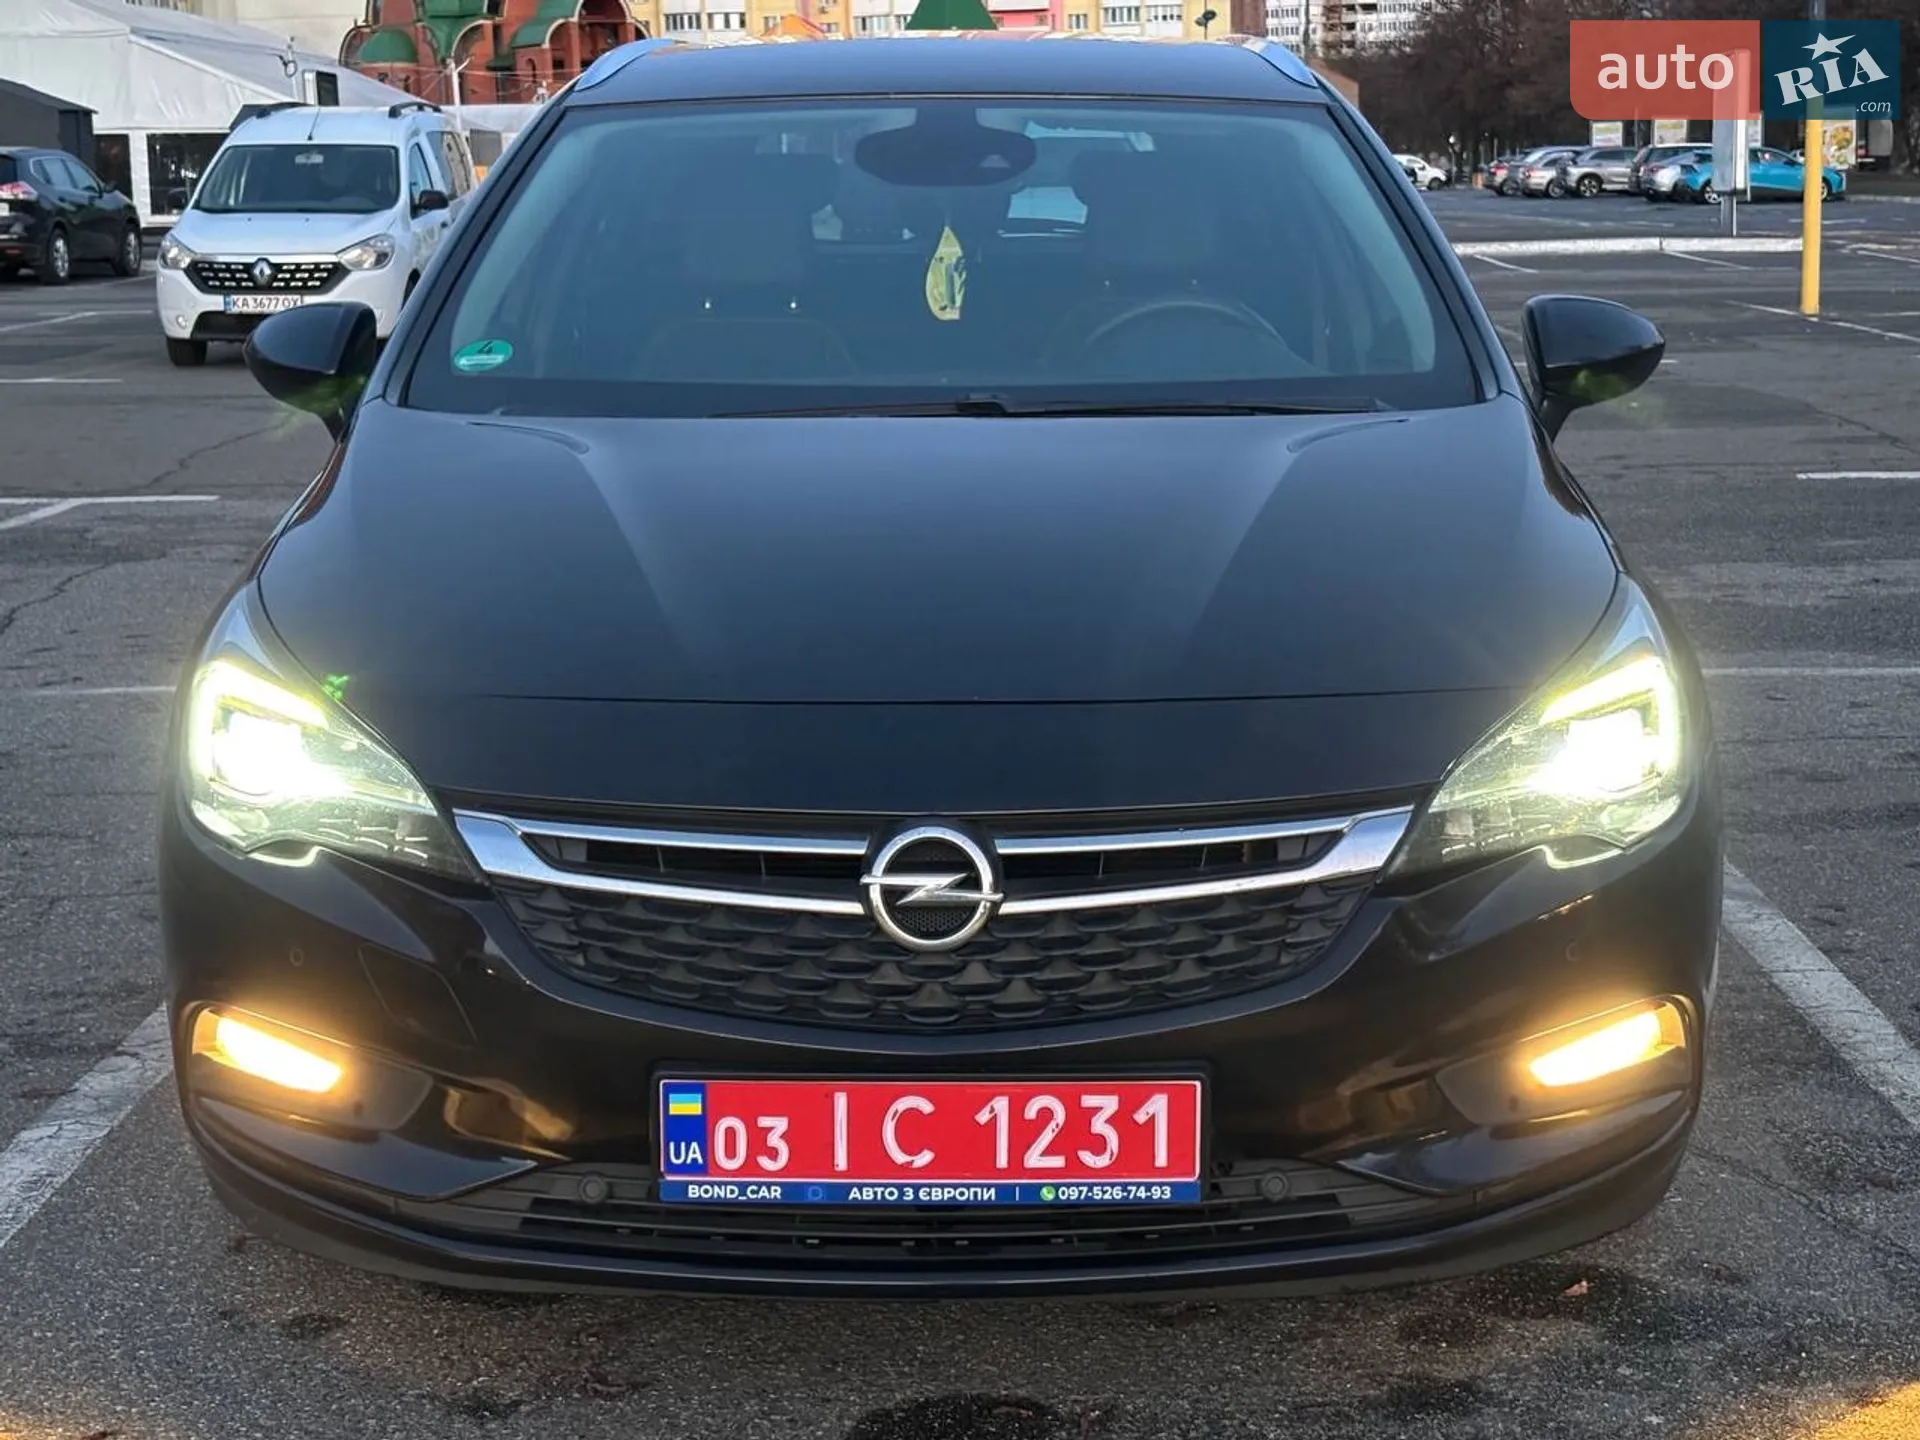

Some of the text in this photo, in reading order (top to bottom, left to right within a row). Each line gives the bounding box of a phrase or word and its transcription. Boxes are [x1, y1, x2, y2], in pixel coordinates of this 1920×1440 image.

[252, 297, 280, 309] 3677
[714, 1116, 790, 1172] 03
[974, 1094, 1168, 1169] 1231
[669, 1141, 704, 1165] UA
[687, 1185, 782, 1200] BOND_CAR
[848, 1187, 898, 1201] АВТО
[918, 1187, 996, 1201] ЄВРОПИ
[1058, 1186, 1172, 1200] 097-526-74-93
